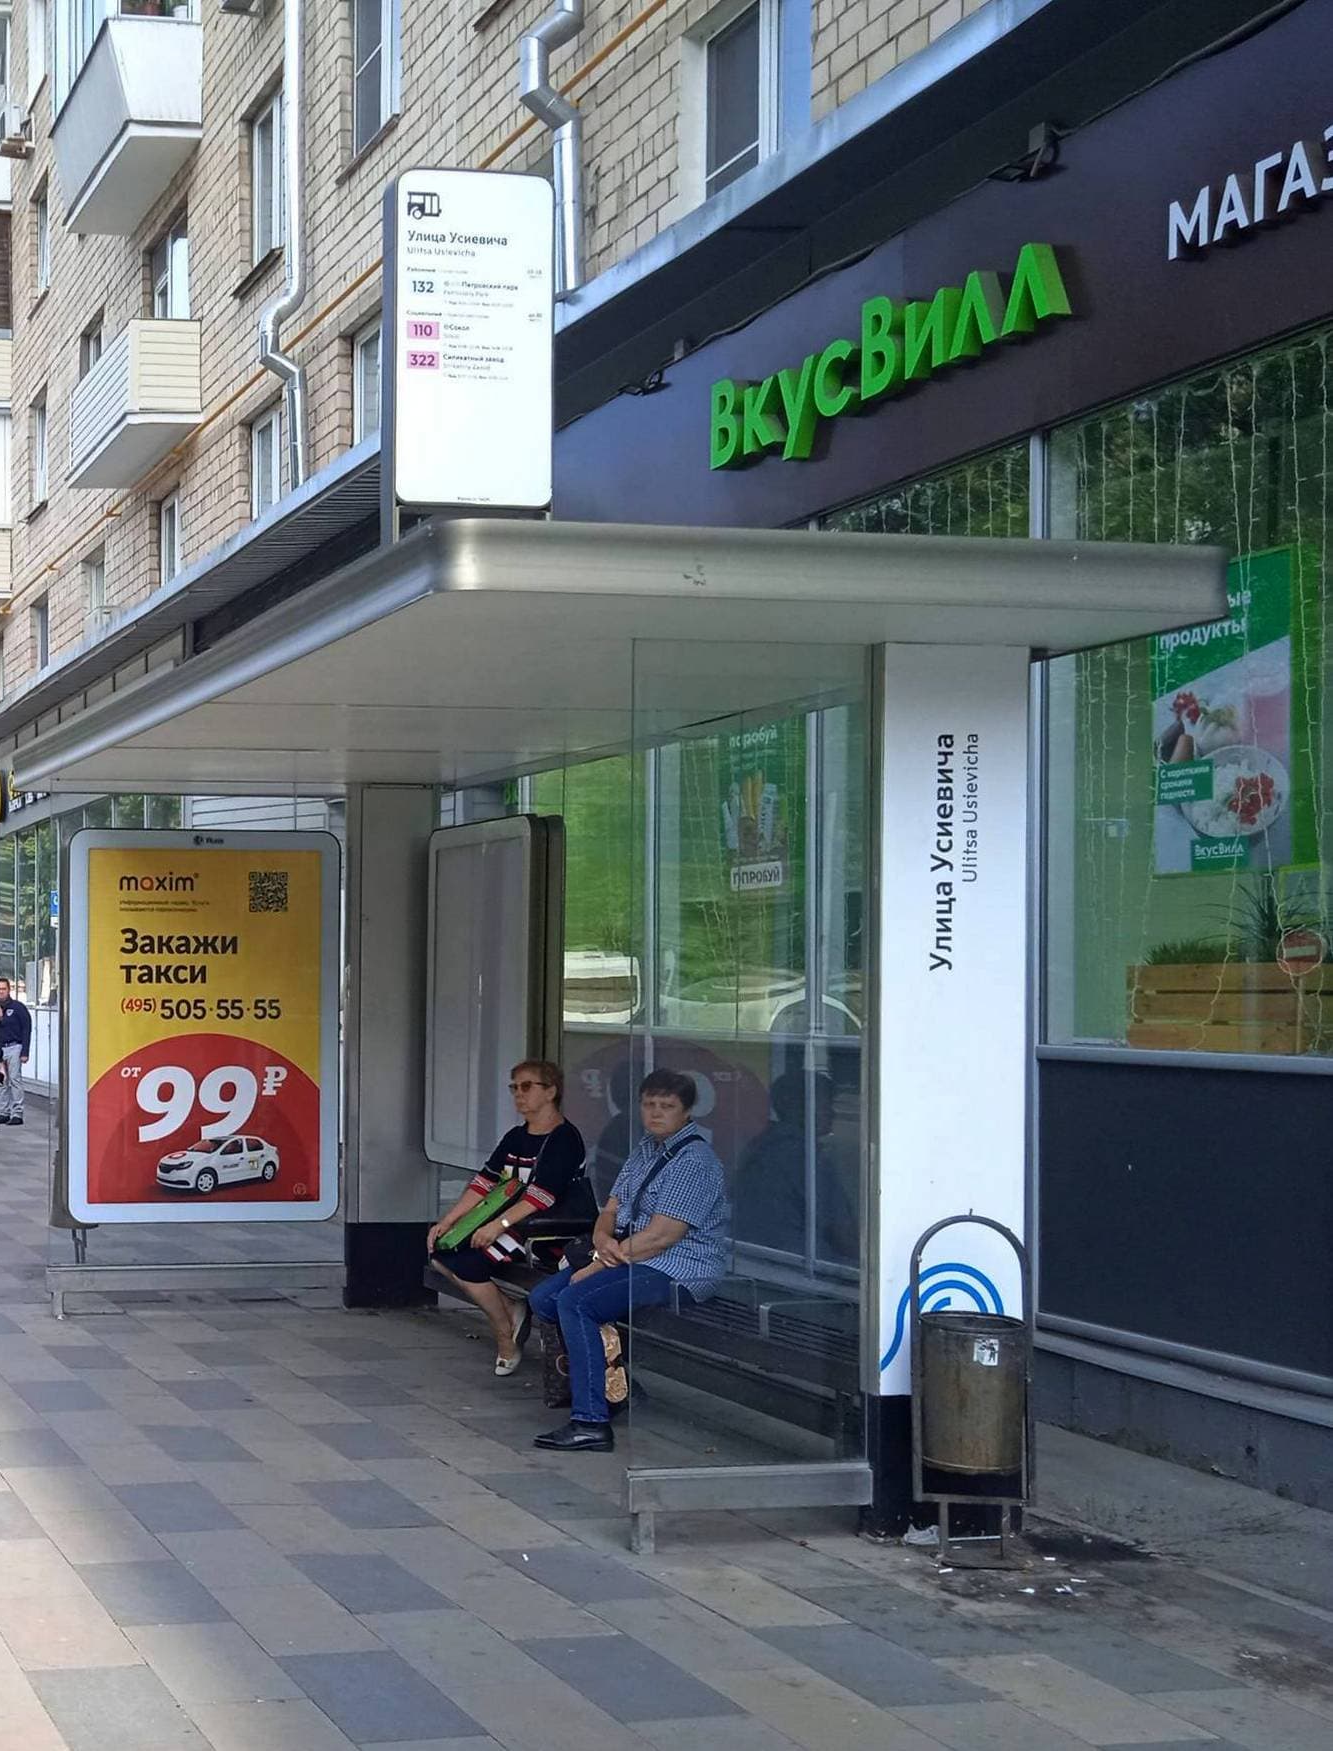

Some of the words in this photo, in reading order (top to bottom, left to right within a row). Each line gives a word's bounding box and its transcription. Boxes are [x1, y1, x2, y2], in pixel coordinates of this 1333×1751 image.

[407, 230, 446, 243] Улица
[450, 232, 508, 246] Усиевича
[412, 280, 434, 293] 132
[413, 324, 433, 337] 110
[410, 354, 435, 367] 322
[962, 733, 978, 823] Usievicha
[930, 733, 954, 872] Усиевича
[962, 829, 977, 882] Ulitsa
[929, 881, 956, 971] Улица
[120, 928, 239, 955] Закажи
[120, 964, 207, 984] такси
[121, 998, 157, 1014] (495)
